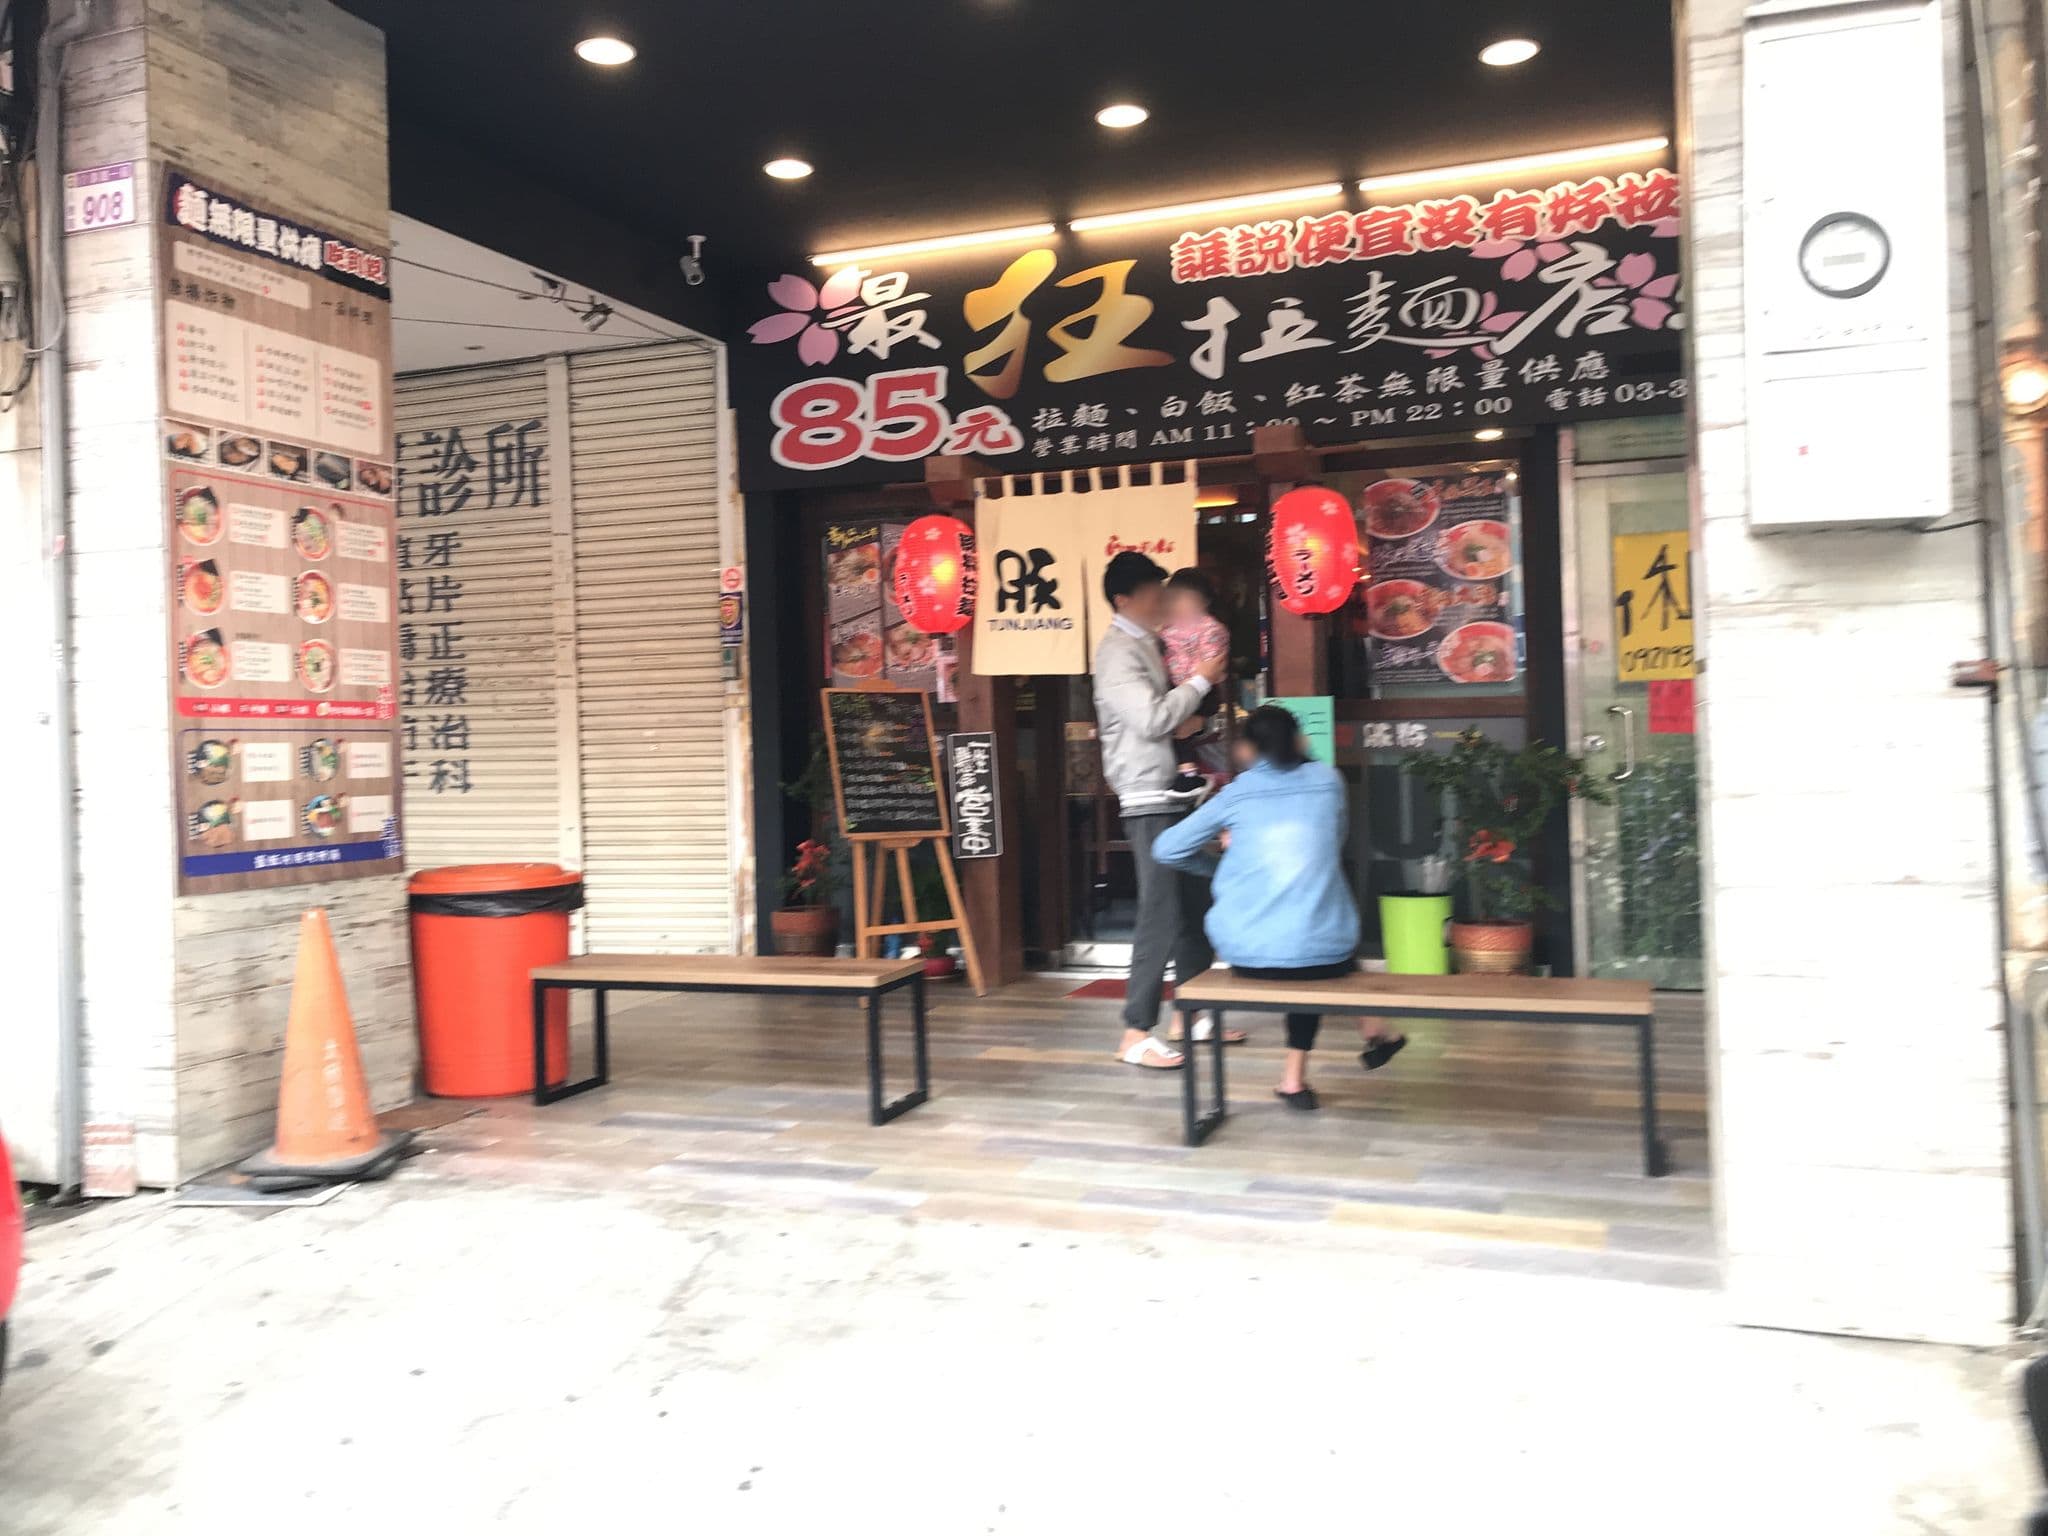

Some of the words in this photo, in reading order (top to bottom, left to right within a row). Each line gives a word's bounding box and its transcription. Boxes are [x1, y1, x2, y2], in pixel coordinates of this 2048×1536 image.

[83, 191, 123, 225] 908
[771, 366, 1024, 470] 85元
[1543, 387, 1608, 412] 電話
[1031, 429, 1138, 458] 營業時間
[1150, 426, 1194, 446] AM
[1350, 407, 1396, 427] PM
[396, 419, 544, 518] 診所
[987, 617, 1073, 632] TUNJIANG
